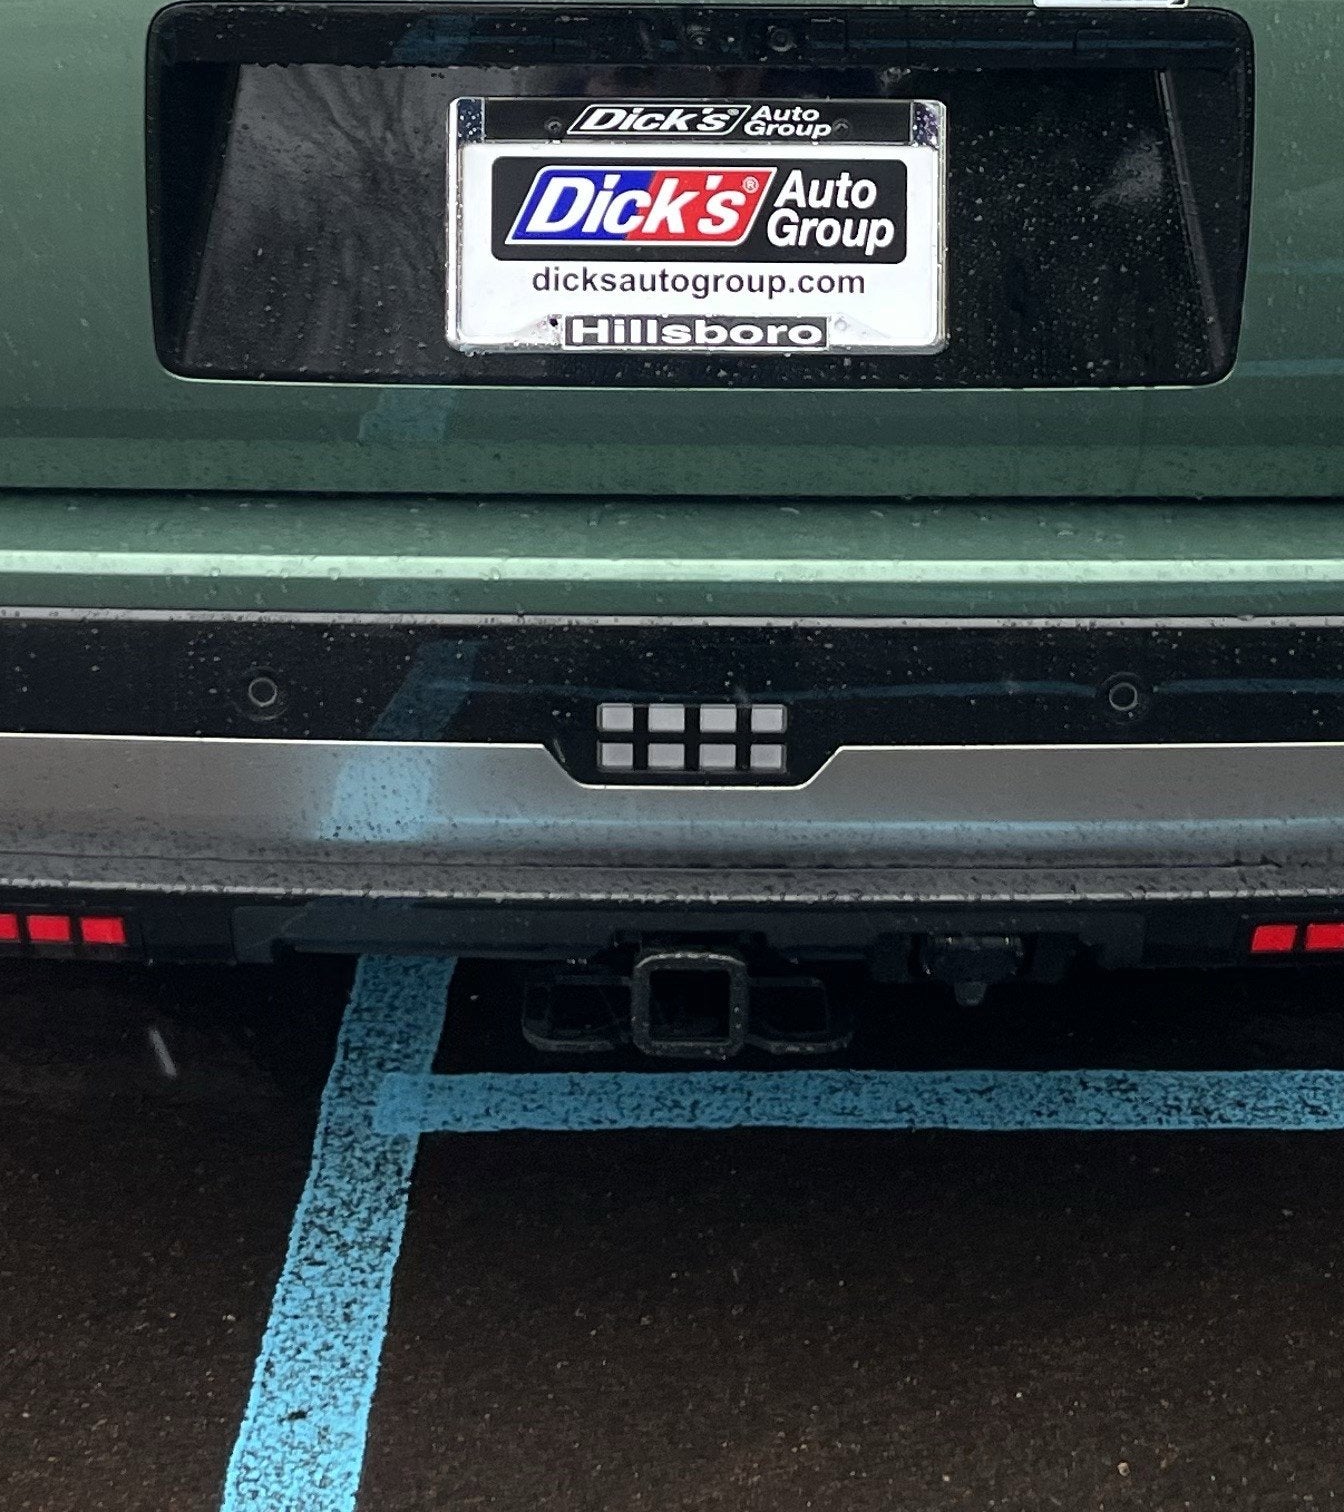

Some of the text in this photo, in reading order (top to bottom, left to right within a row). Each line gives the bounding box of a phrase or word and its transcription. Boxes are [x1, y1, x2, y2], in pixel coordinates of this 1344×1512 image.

[579, 105, 820, 132] Dick's Auto
[743, 120, 832, 139] Group
[525, 169, 878, 235] Dick's Auto
[766, 208, 896, 256] Group
[531, 265, 866, 300] dicksautogroup.com
[571, 318, 824, 345] Hillsboro
